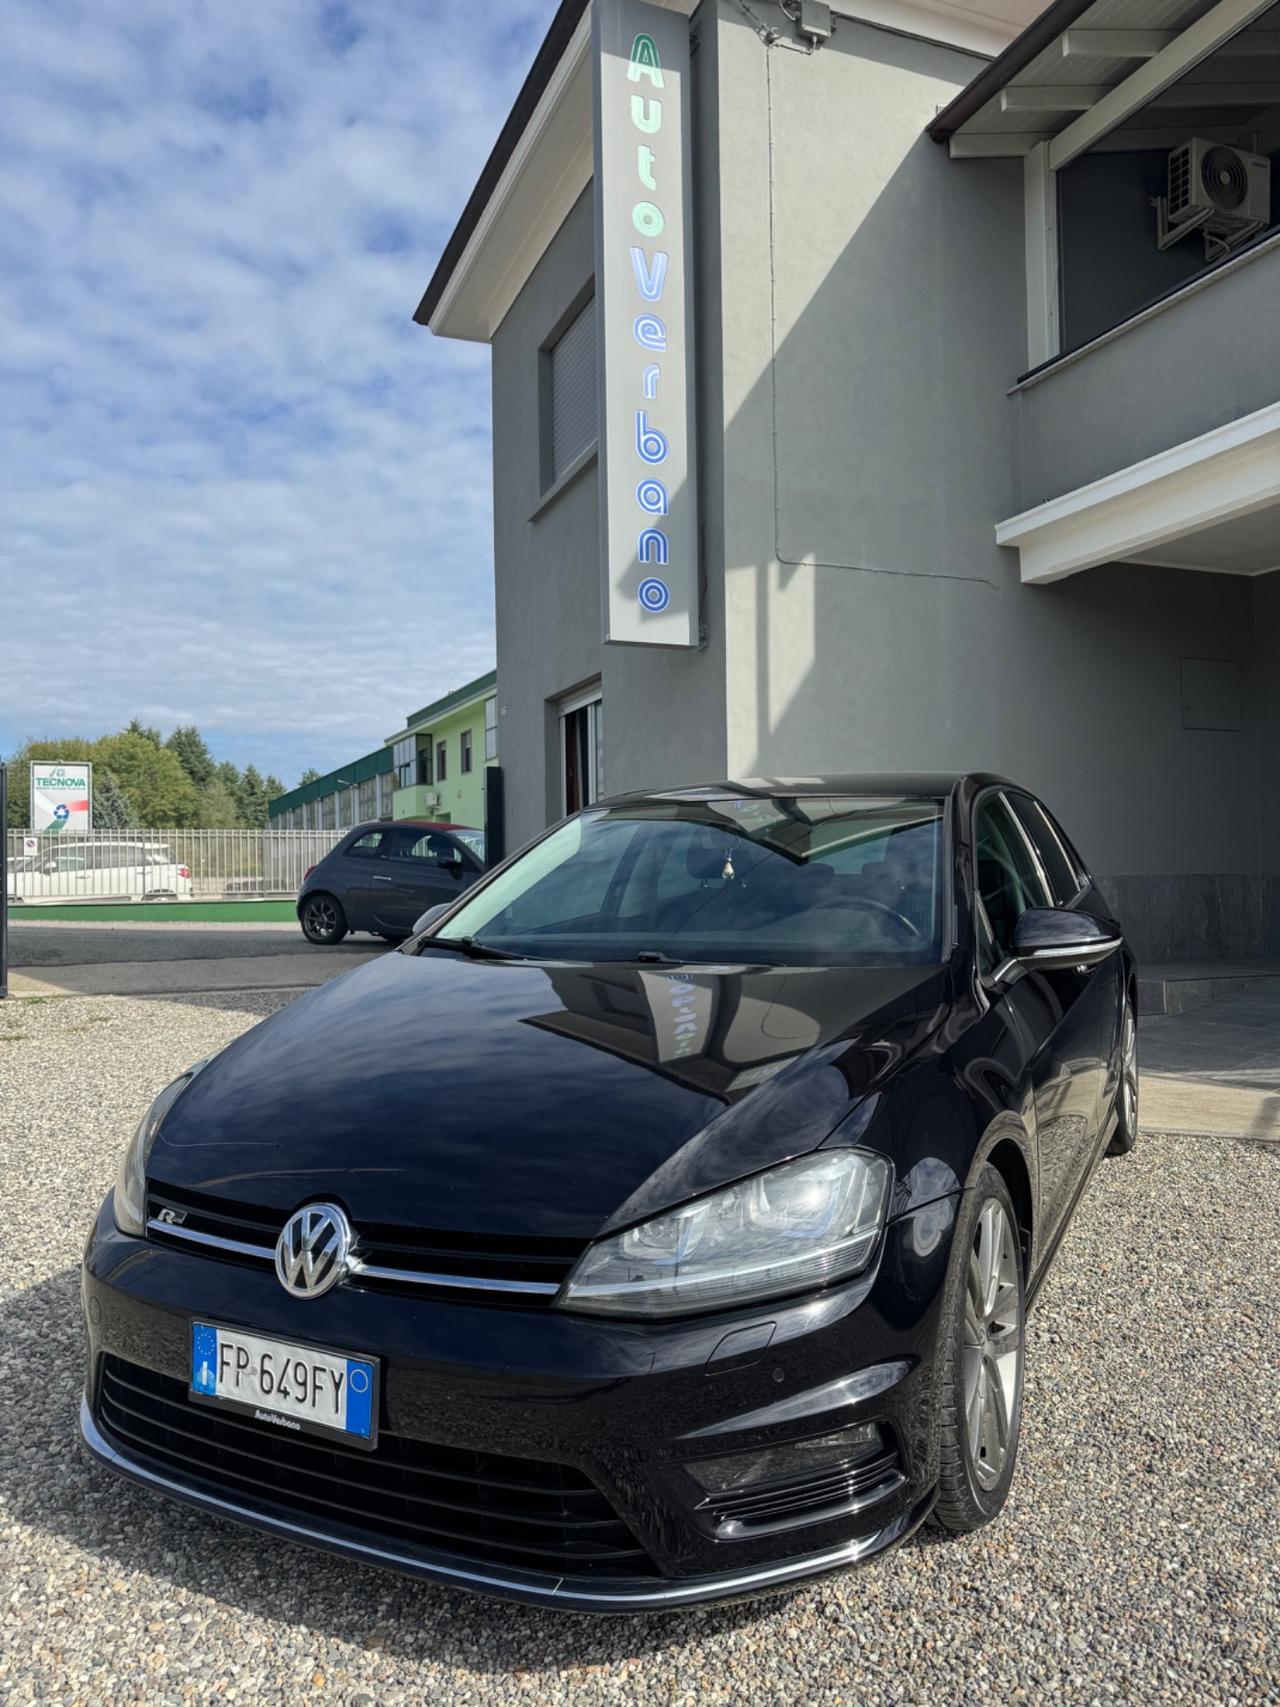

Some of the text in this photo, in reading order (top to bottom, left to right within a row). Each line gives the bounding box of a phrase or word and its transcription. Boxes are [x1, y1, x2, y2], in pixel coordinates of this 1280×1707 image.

[36, 777, 86, 787] TECNOVA
[218, 1342, 344, 1414] FP 649FY
